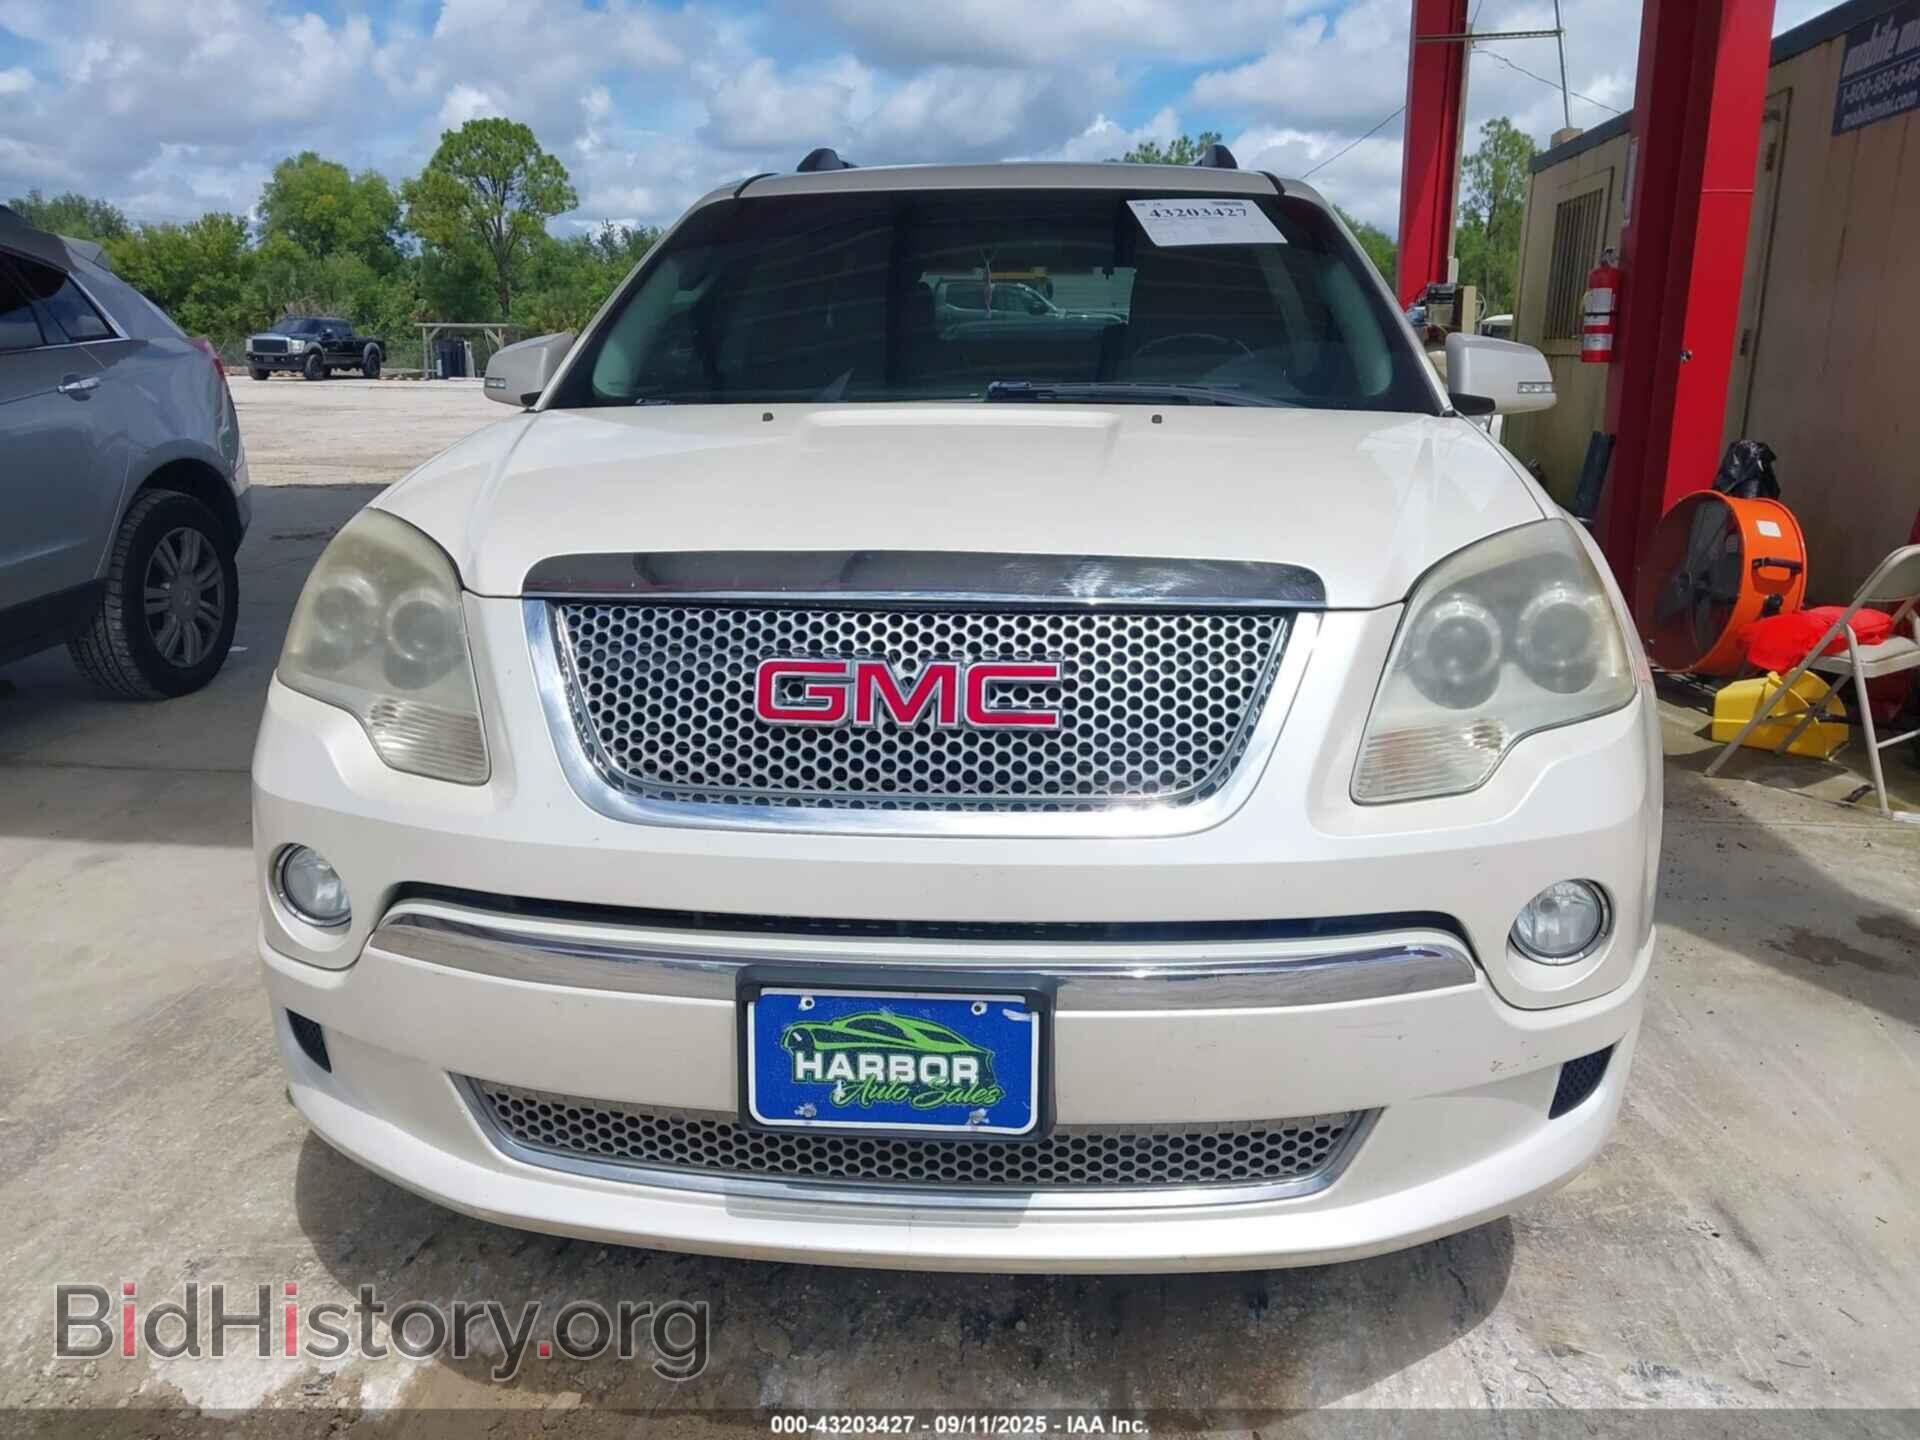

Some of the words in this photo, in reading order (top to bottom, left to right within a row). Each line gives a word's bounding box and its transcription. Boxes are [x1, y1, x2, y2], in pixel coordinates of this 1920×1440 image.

[1150, 208, 1247, 217] 43203427
[754, 658, 1063, 730] GMC
[796, 1052, 980, 1084] HARBOR
[836, 1073, 910, 1106] Auto
[911, 1075, 1004, 1109] Sales
